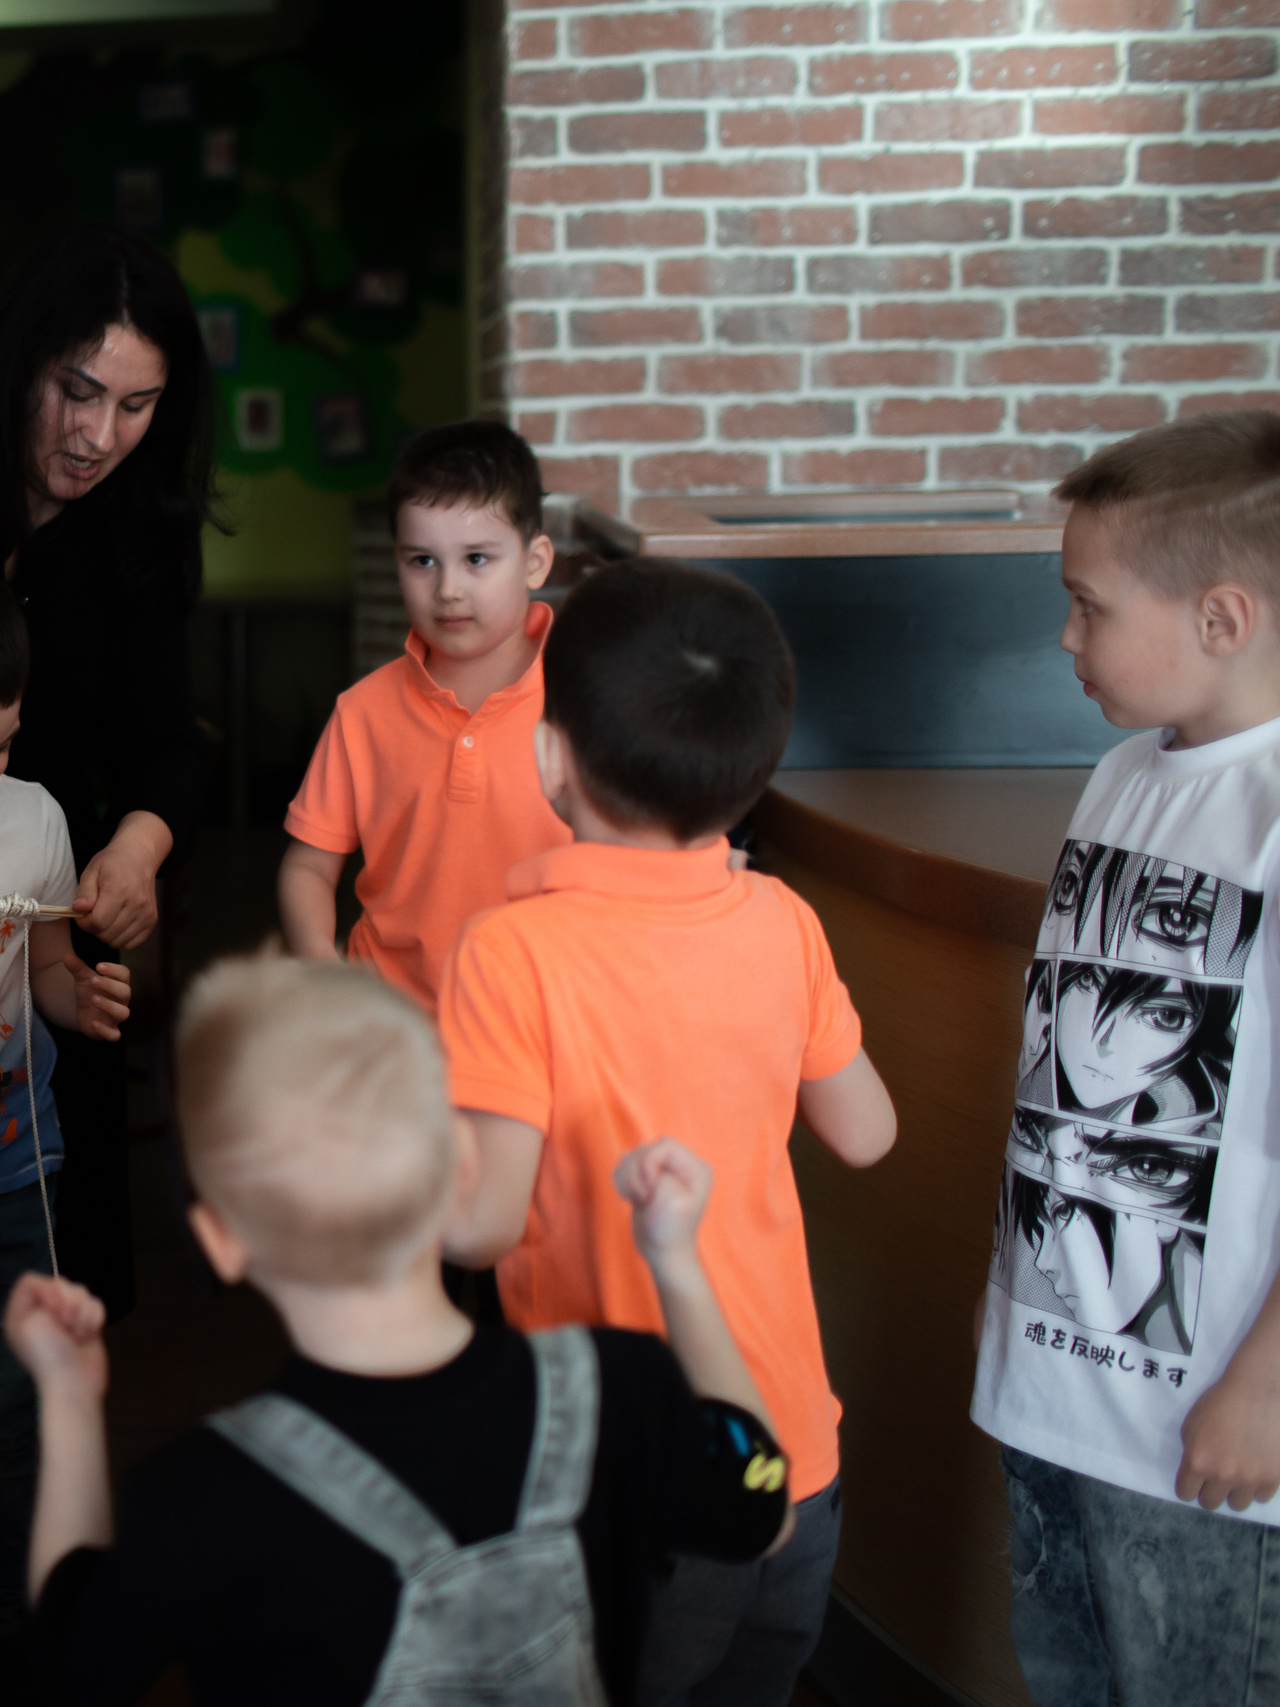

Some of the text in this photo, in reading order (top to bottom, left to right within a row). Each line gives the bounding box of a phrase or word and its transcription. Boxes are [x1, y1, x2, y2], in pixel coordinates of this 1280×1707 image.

[1024, 1321, 1188, 1389] 魂を反映します
